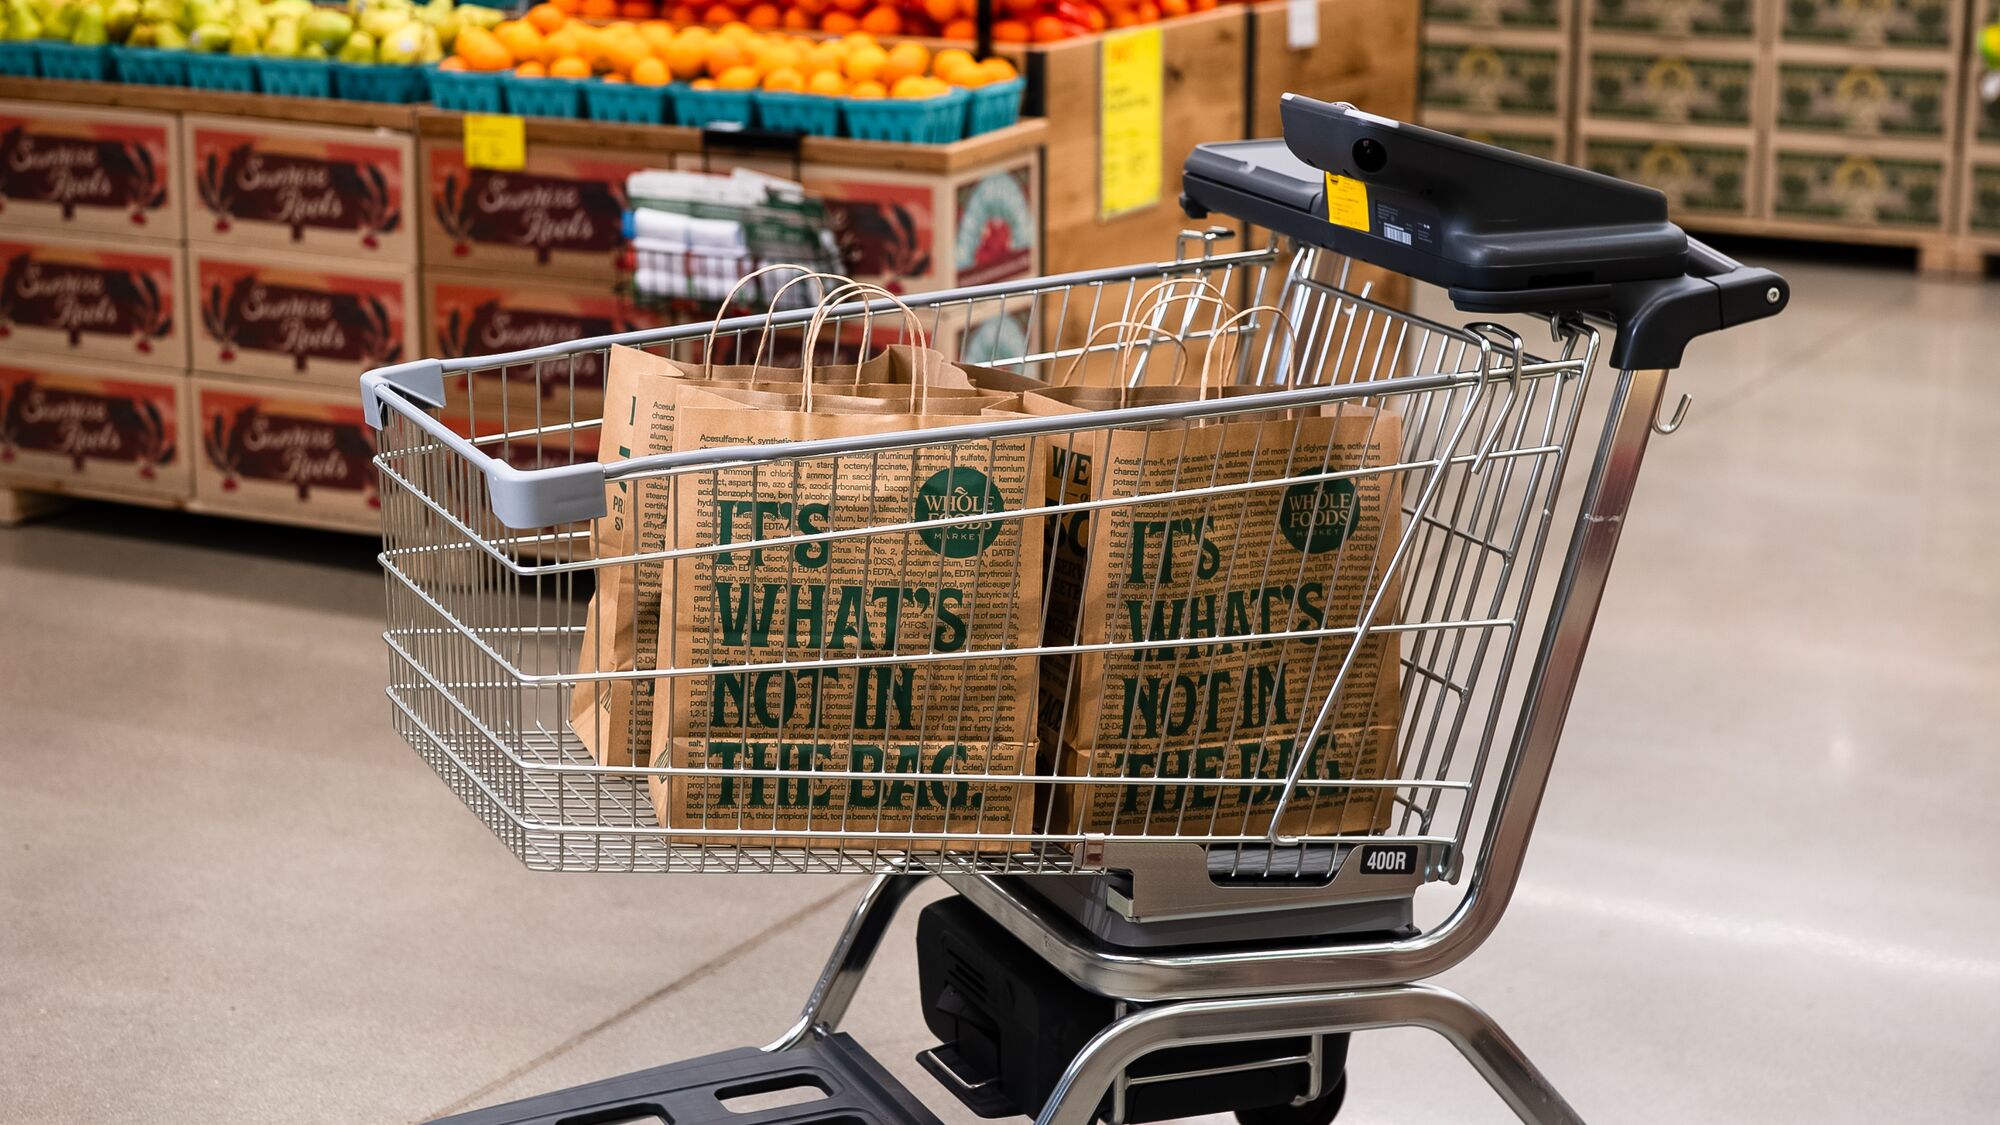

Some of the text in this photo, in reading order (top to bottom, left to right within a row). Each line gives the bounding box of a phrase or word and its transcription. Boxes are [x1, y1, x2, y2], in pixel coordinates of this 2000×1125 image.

[700, 434, 756, 446] Acesulfame-K,
[698, 478, 726, 487] extrct,
[924, 494, 995, 512] WHOLE
[1290, 493, 1351, 511] WHOLE
[1289, 510, 1349, 528] FOODS
[873, 547, 887, 555] No.
[890, 548, 897, 556] 2,
[692, 647, 729, 656] sepaated
[711, 663, 838, 729] NOT
[854, 664, 917, 730] IN
[1121, 671, 1231, 739] NOT
[1241, 662, 1290, 728] IN
[706, 742, 832, 807] THE
[1367, 852, 1406, 870] 400R
